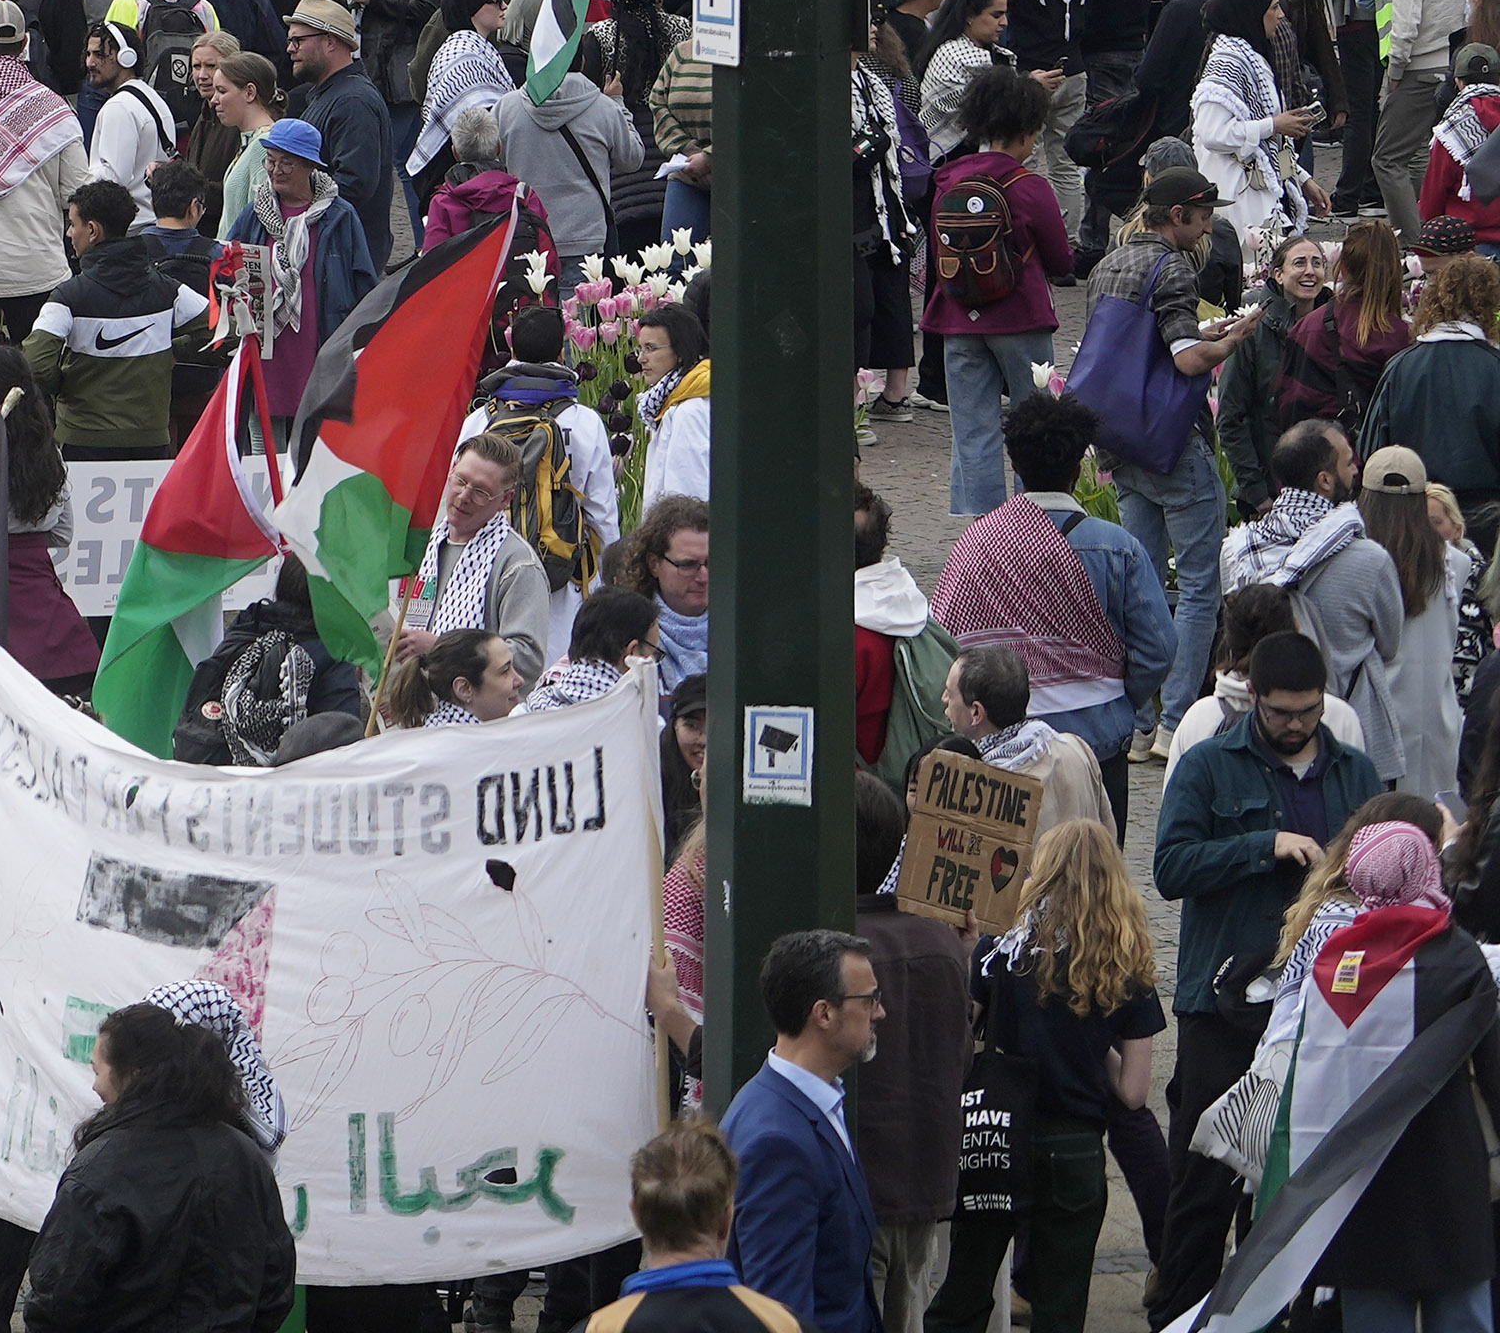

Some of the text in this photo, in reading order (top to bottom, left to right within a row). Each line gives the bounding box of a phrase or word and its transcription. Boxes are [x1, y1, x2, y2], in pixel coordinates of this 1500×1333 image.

[925, 761, 1031, 827] PALESTINE
[937, 824, 983, 855] WILL BE
[925, 854, 980, 911] FREE
[965, 1109, 1011, 1128] HAVE
[976, 1194, 1012, 1203] KVINNA
[976, 1202, 1012, 1211] KVINNA
